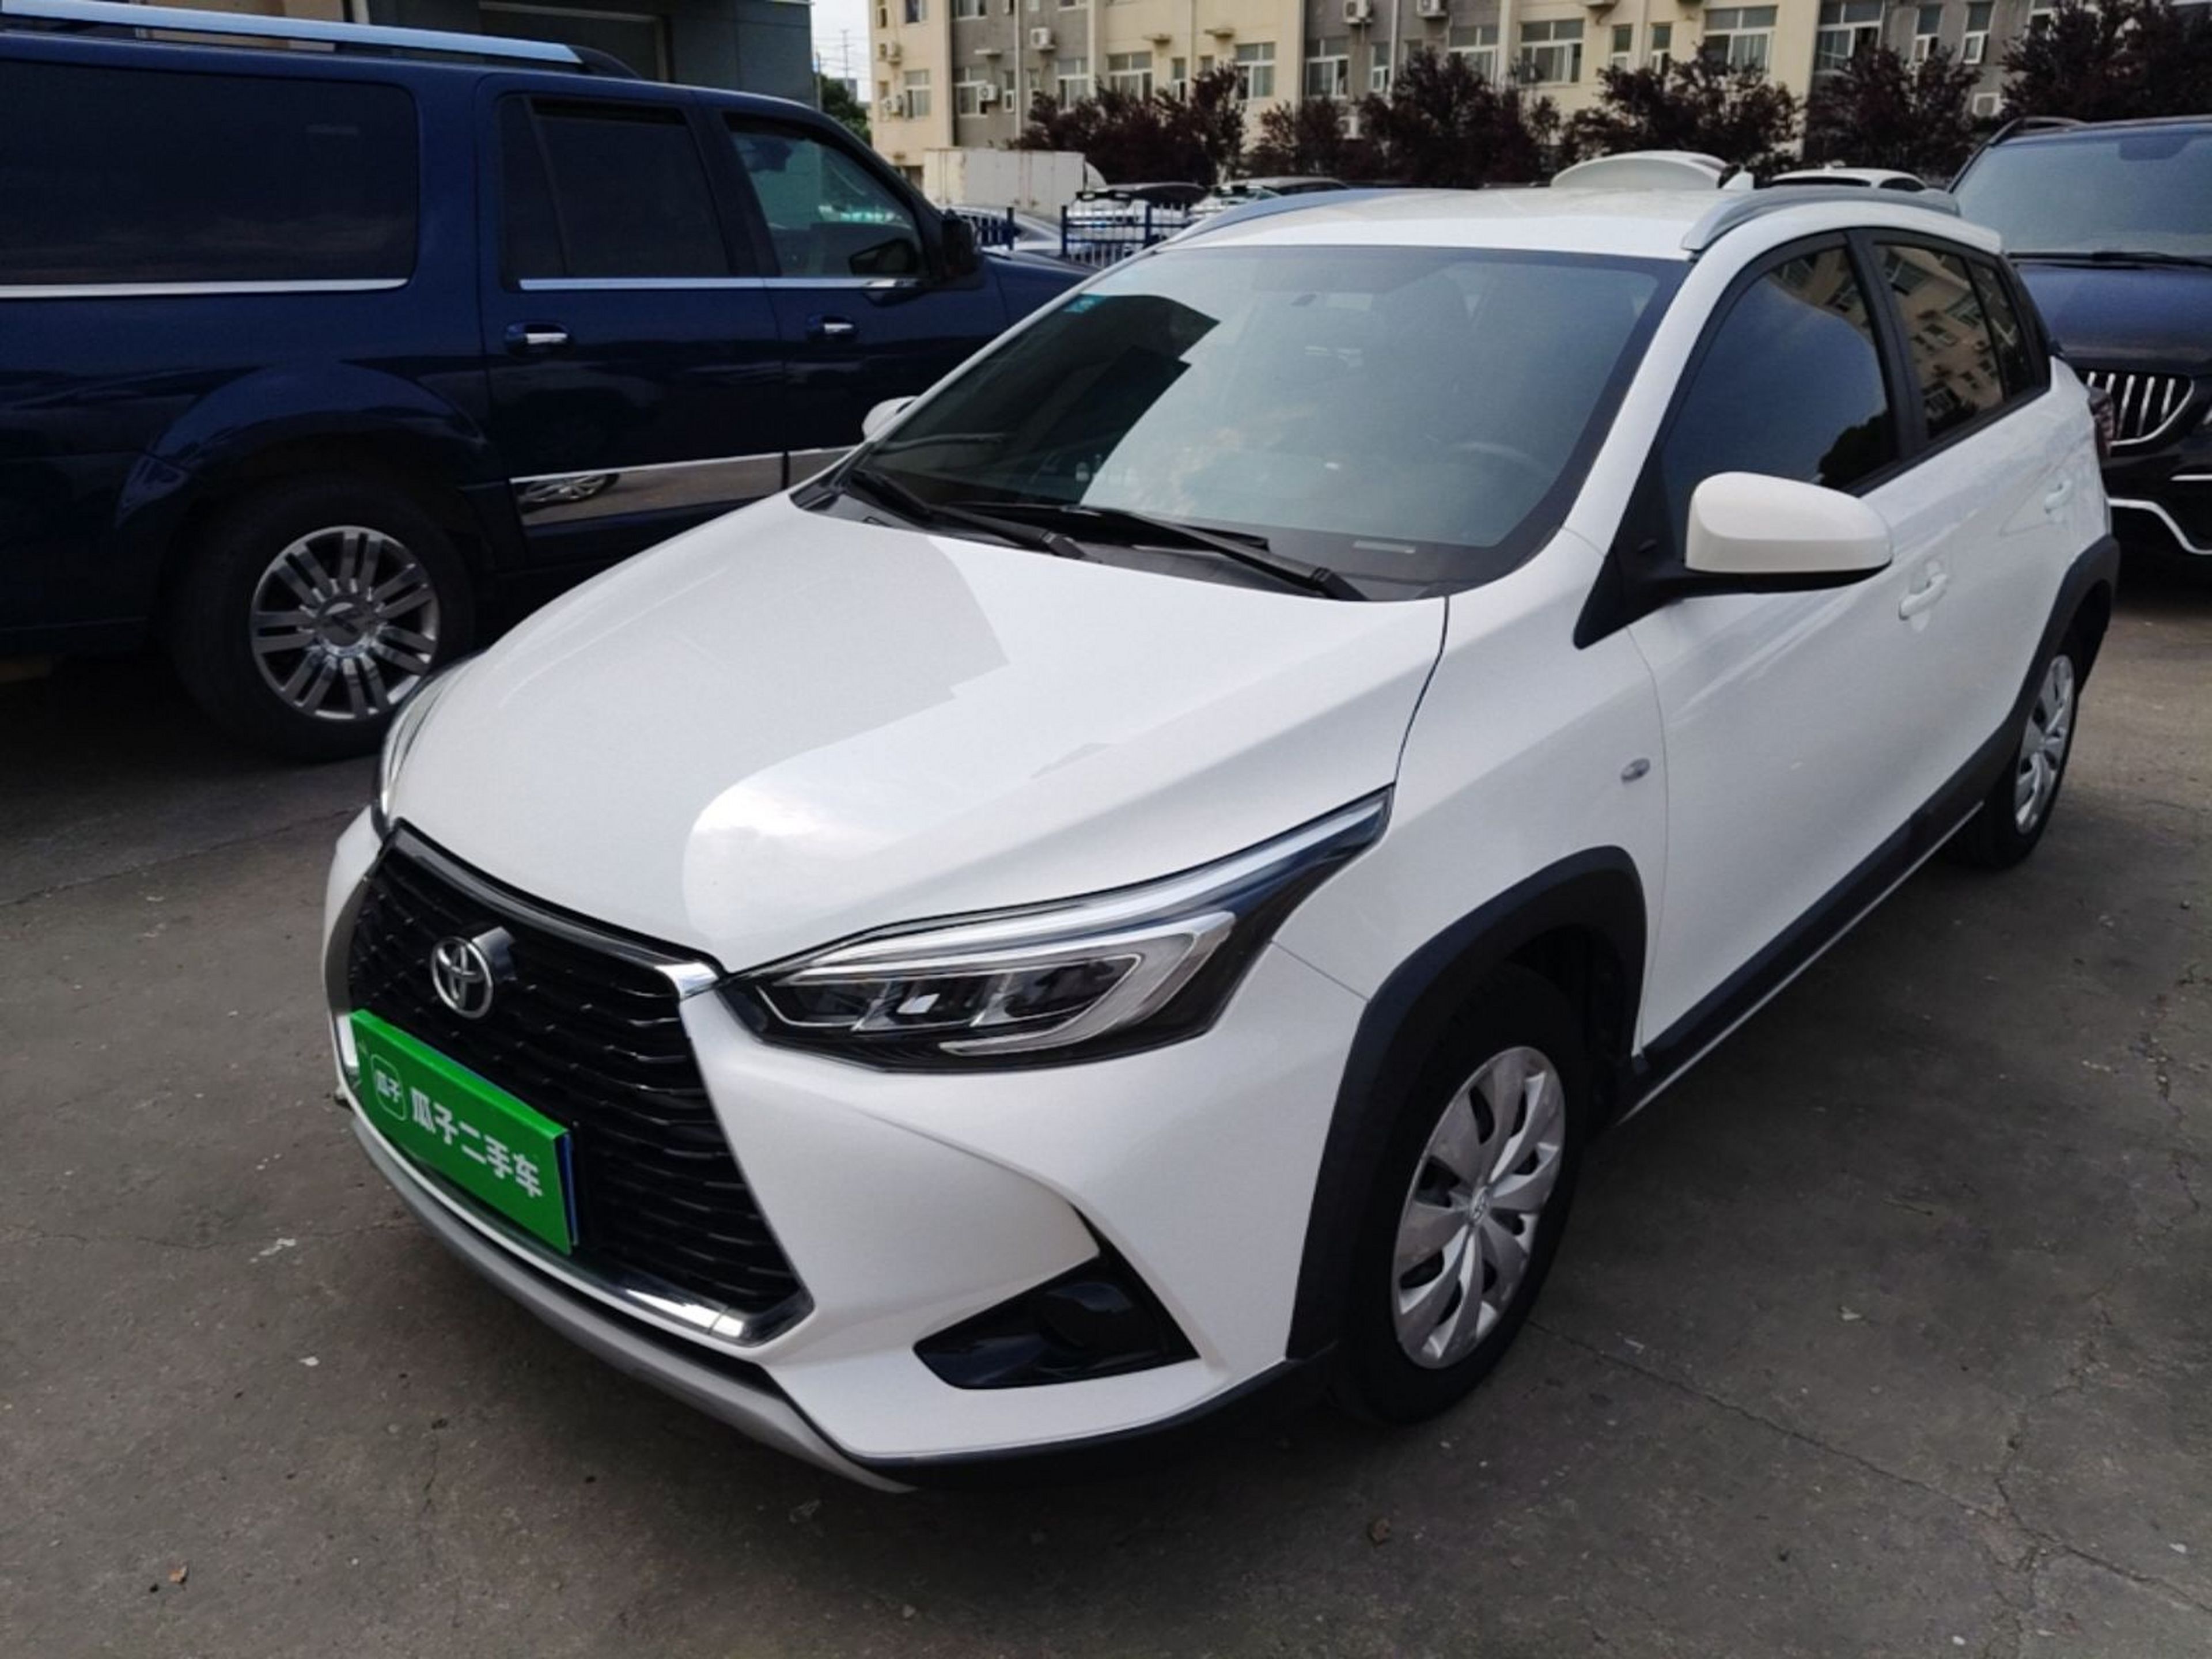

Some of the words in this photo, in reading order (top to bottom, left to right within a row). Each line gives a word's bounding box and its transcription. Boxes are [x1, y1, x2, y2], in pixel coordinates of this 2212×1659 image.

[410, 1086, 543, 1198] 瓜子二手车
